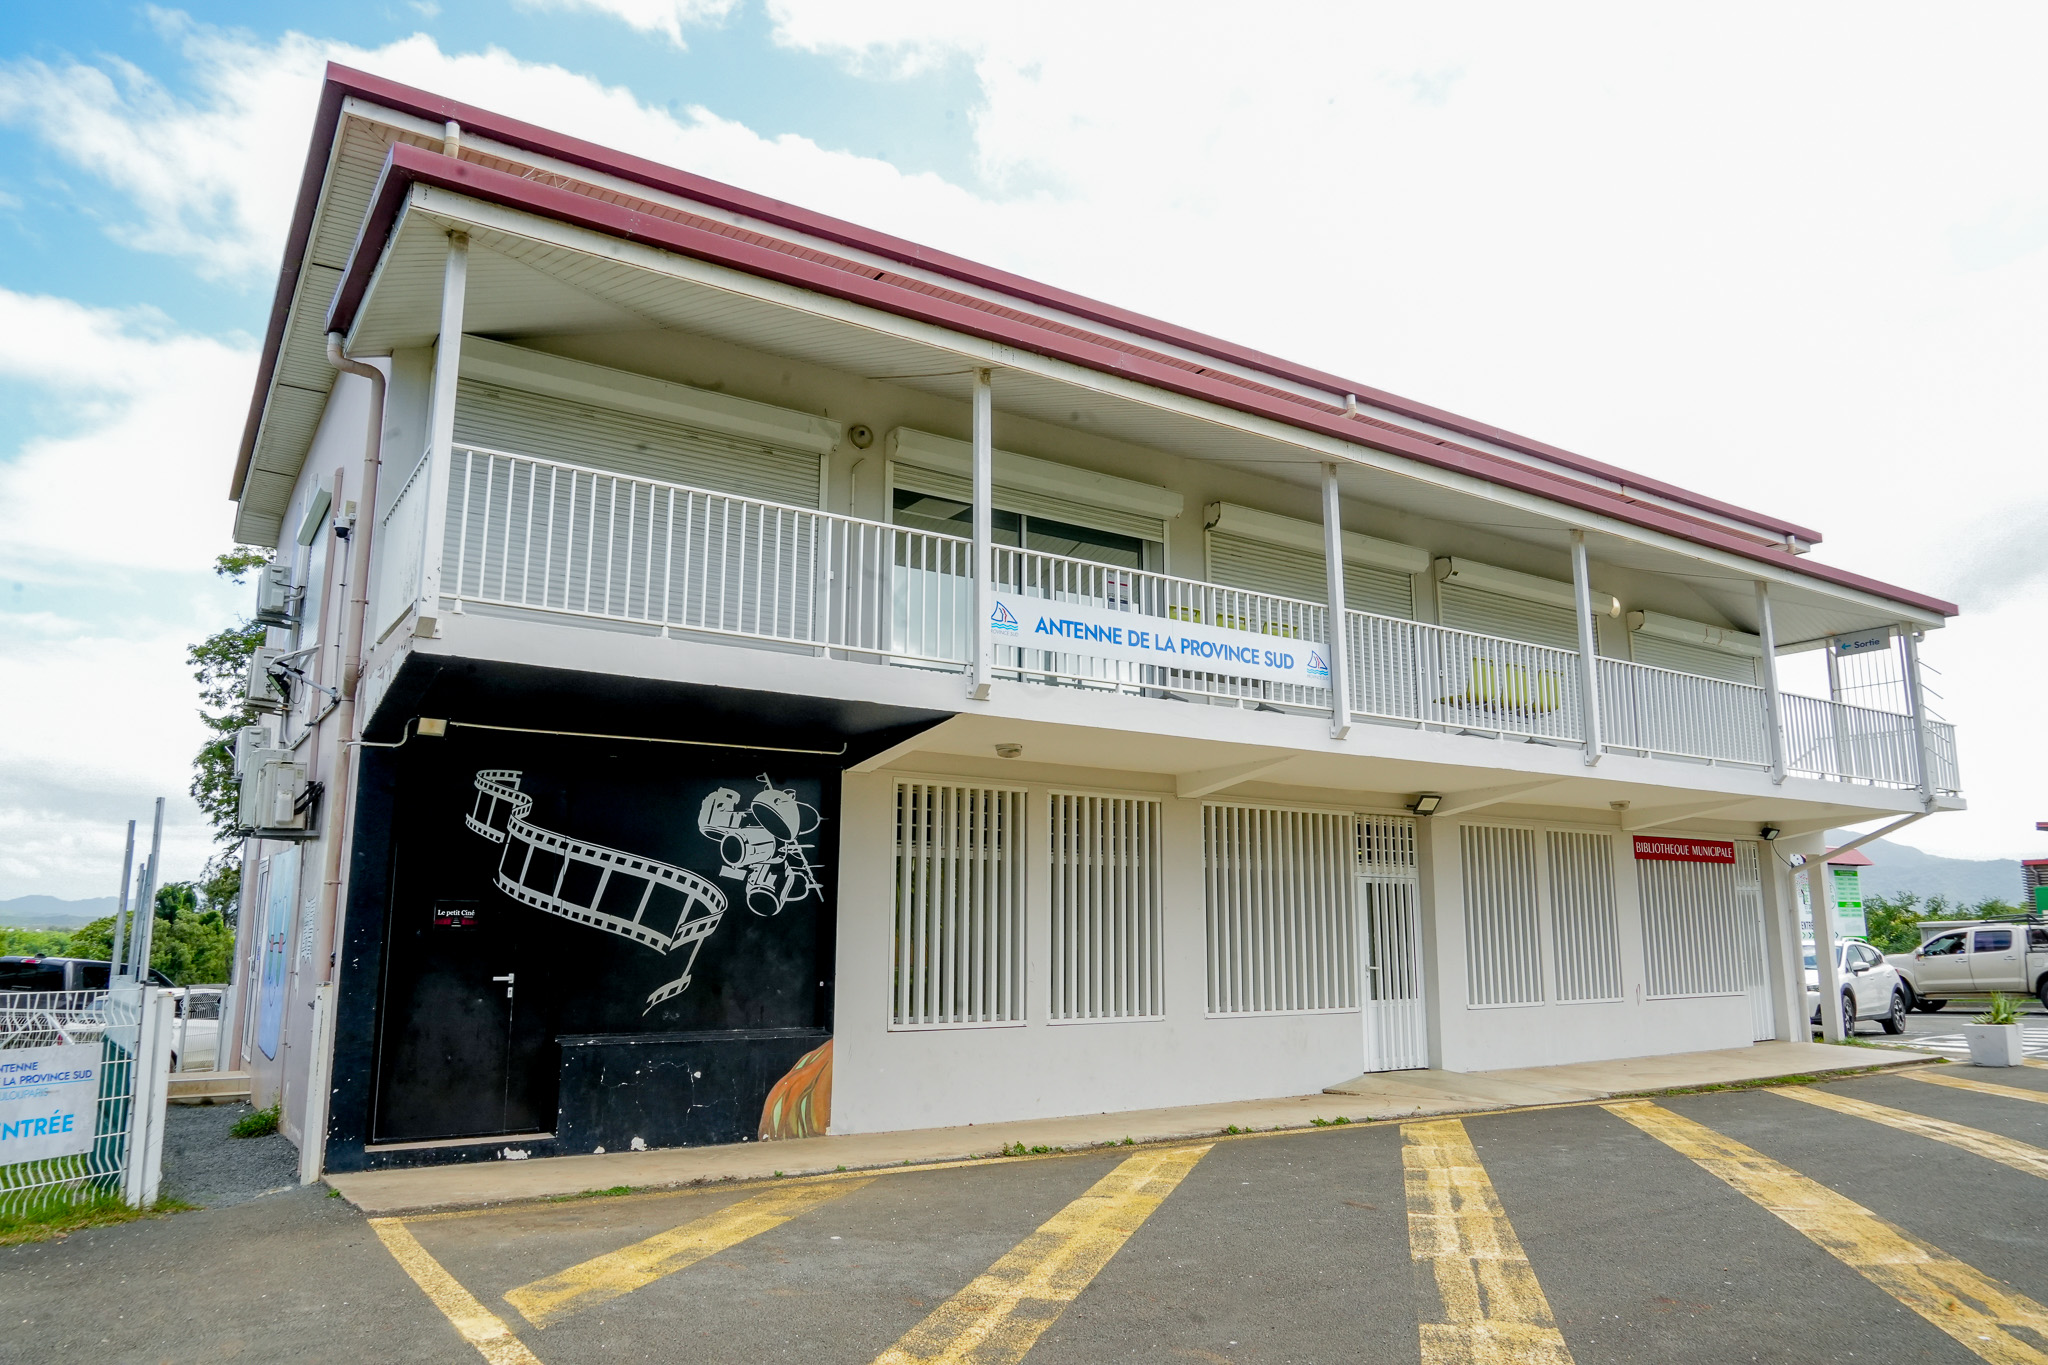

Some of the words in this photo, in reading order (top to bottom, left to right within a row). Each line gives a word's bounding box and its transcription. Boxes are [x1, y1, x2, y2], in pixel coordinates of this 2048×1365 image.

[1035, 616, 1122, 645] ANTENNE
[1128, 629, 1150, 649] DE
[1155, 633, 1176, 653] LA
[1181, 638, 1260, 665] PROVINCE
[1264, 650, 1294, 669] SUD
[1854, 638, 1880, 649] Sortie
[1636, 842, 1690, 856] BIBLIOTHEQUE
[1692, 845, 1732, 858] MUNICIPALE
[3, 1077, 16, 1087] LA
[20, 1071, 70, 1084] PROVINCE
[73, 1069, 93, 1080] SUD
[0, 1109, 74, 1140] NTRÉE
